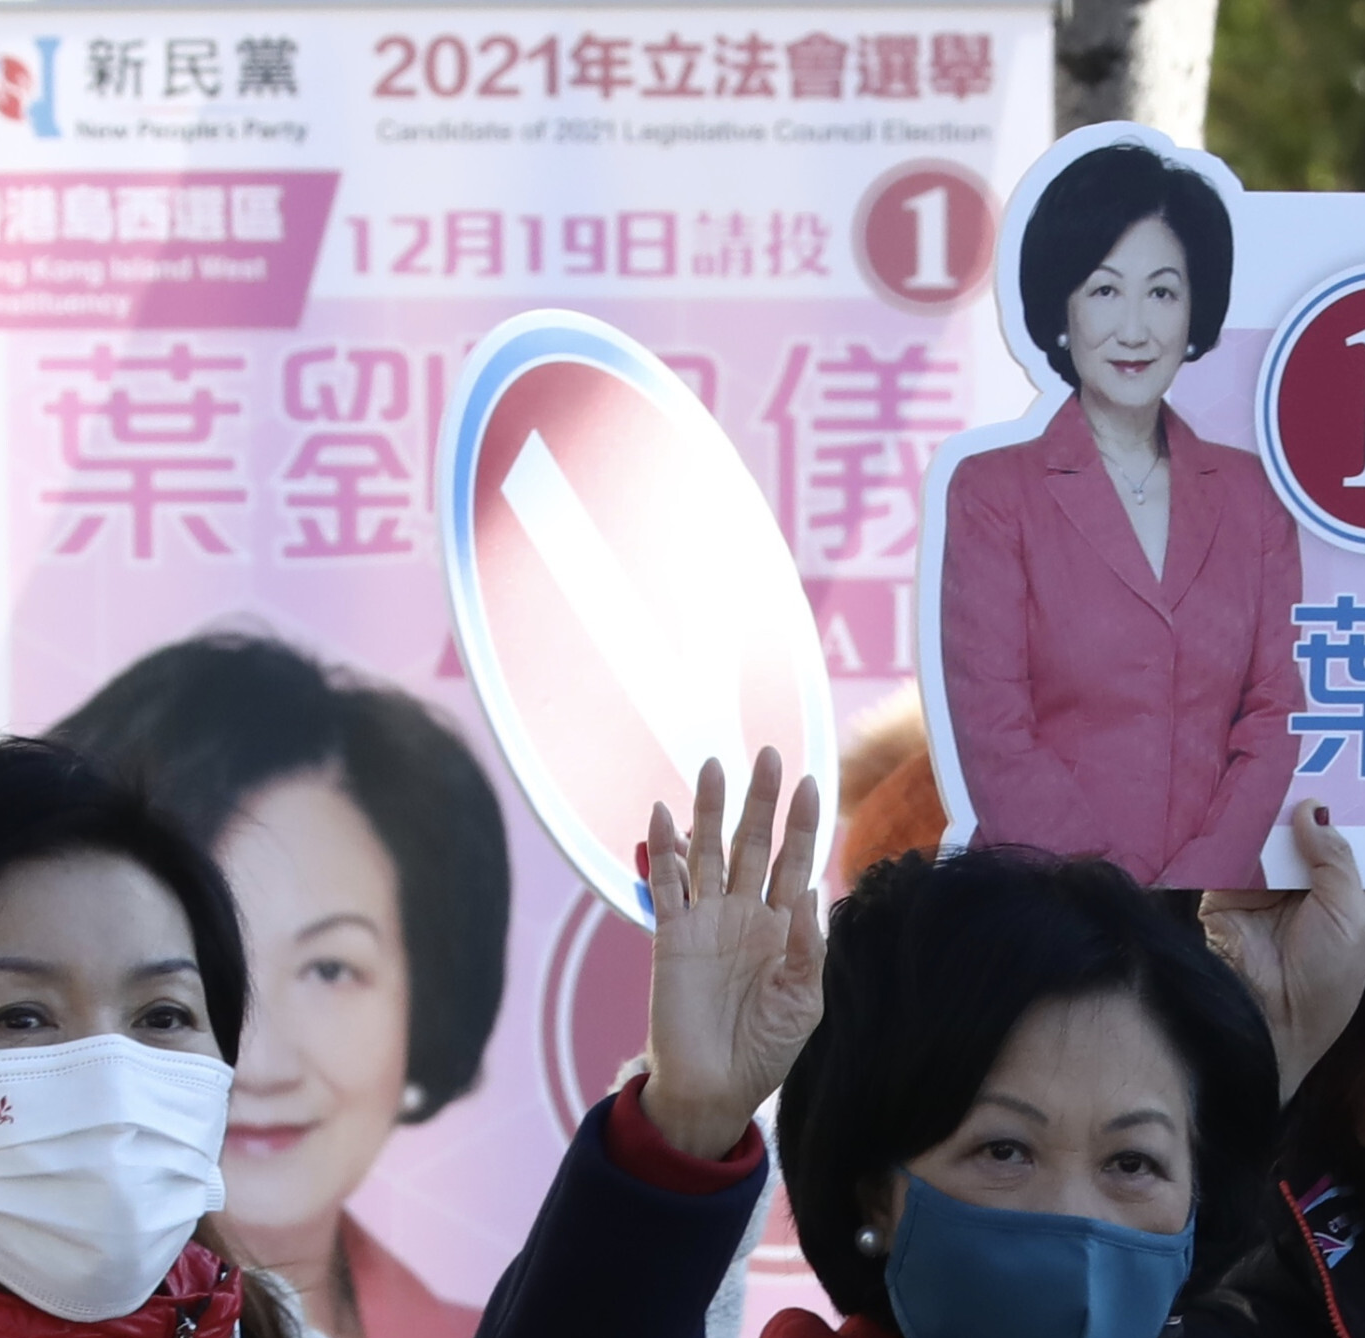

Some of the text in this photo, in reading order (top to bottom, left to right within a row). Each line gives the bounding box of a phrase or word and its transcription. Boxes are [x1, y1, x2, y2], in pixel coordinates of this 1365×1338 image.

[85, 35, 300, 98] 新民黨
[372, 32, 995, 100] 2021年立法會選舉
[377, 118, 992, 147] Candidate of 2021 Legislative Council Election
[345, 184, 959, 290] 12月19日請投 1
